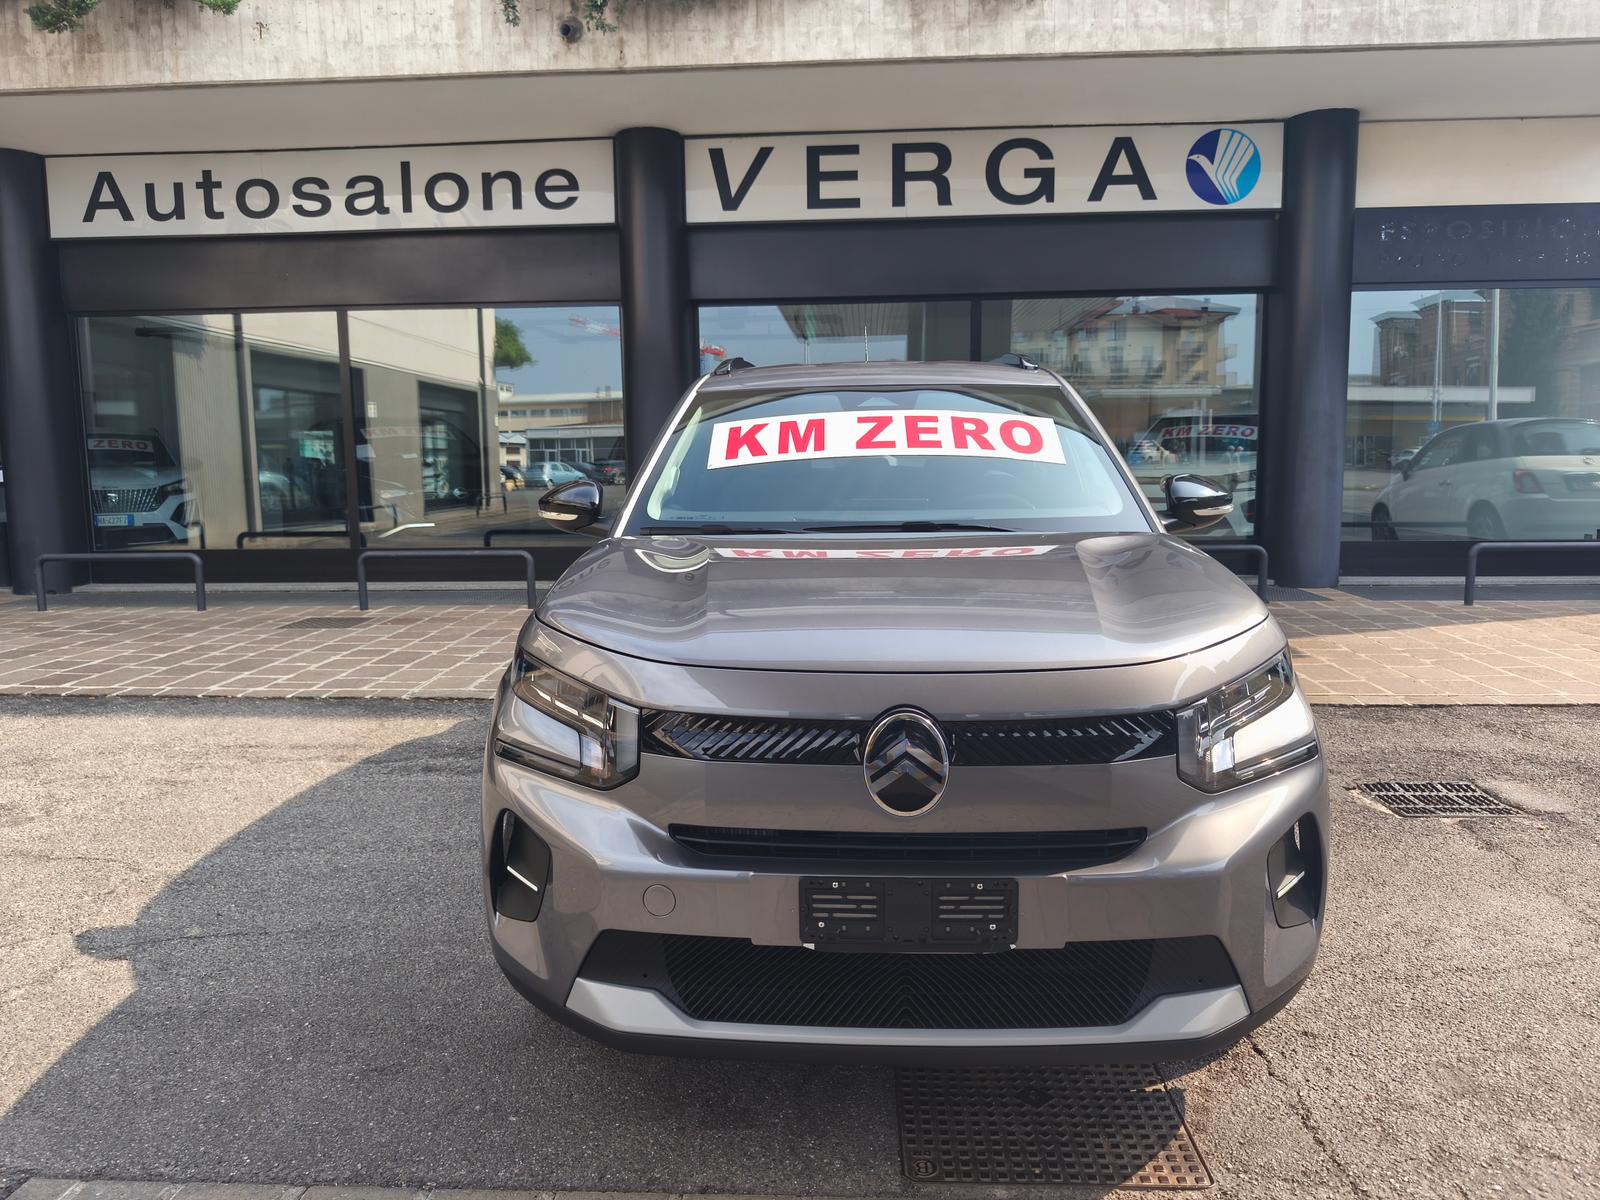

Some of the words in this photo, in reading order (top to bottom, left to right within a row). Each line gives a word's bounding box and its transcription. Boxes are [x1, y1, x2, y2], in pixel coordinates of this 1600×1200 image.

[83, 161, 579, 223] Autosalone
[707, 136, 1157, 212] VERGA
[94, 440, 148, 450] ZERO
[725, 418, 826, 461] KM
[855, 415, 1044, 455] ZERO
[1163, 426, 1192, 438] KM
[1199, 424, 1255, 438] ZERO
